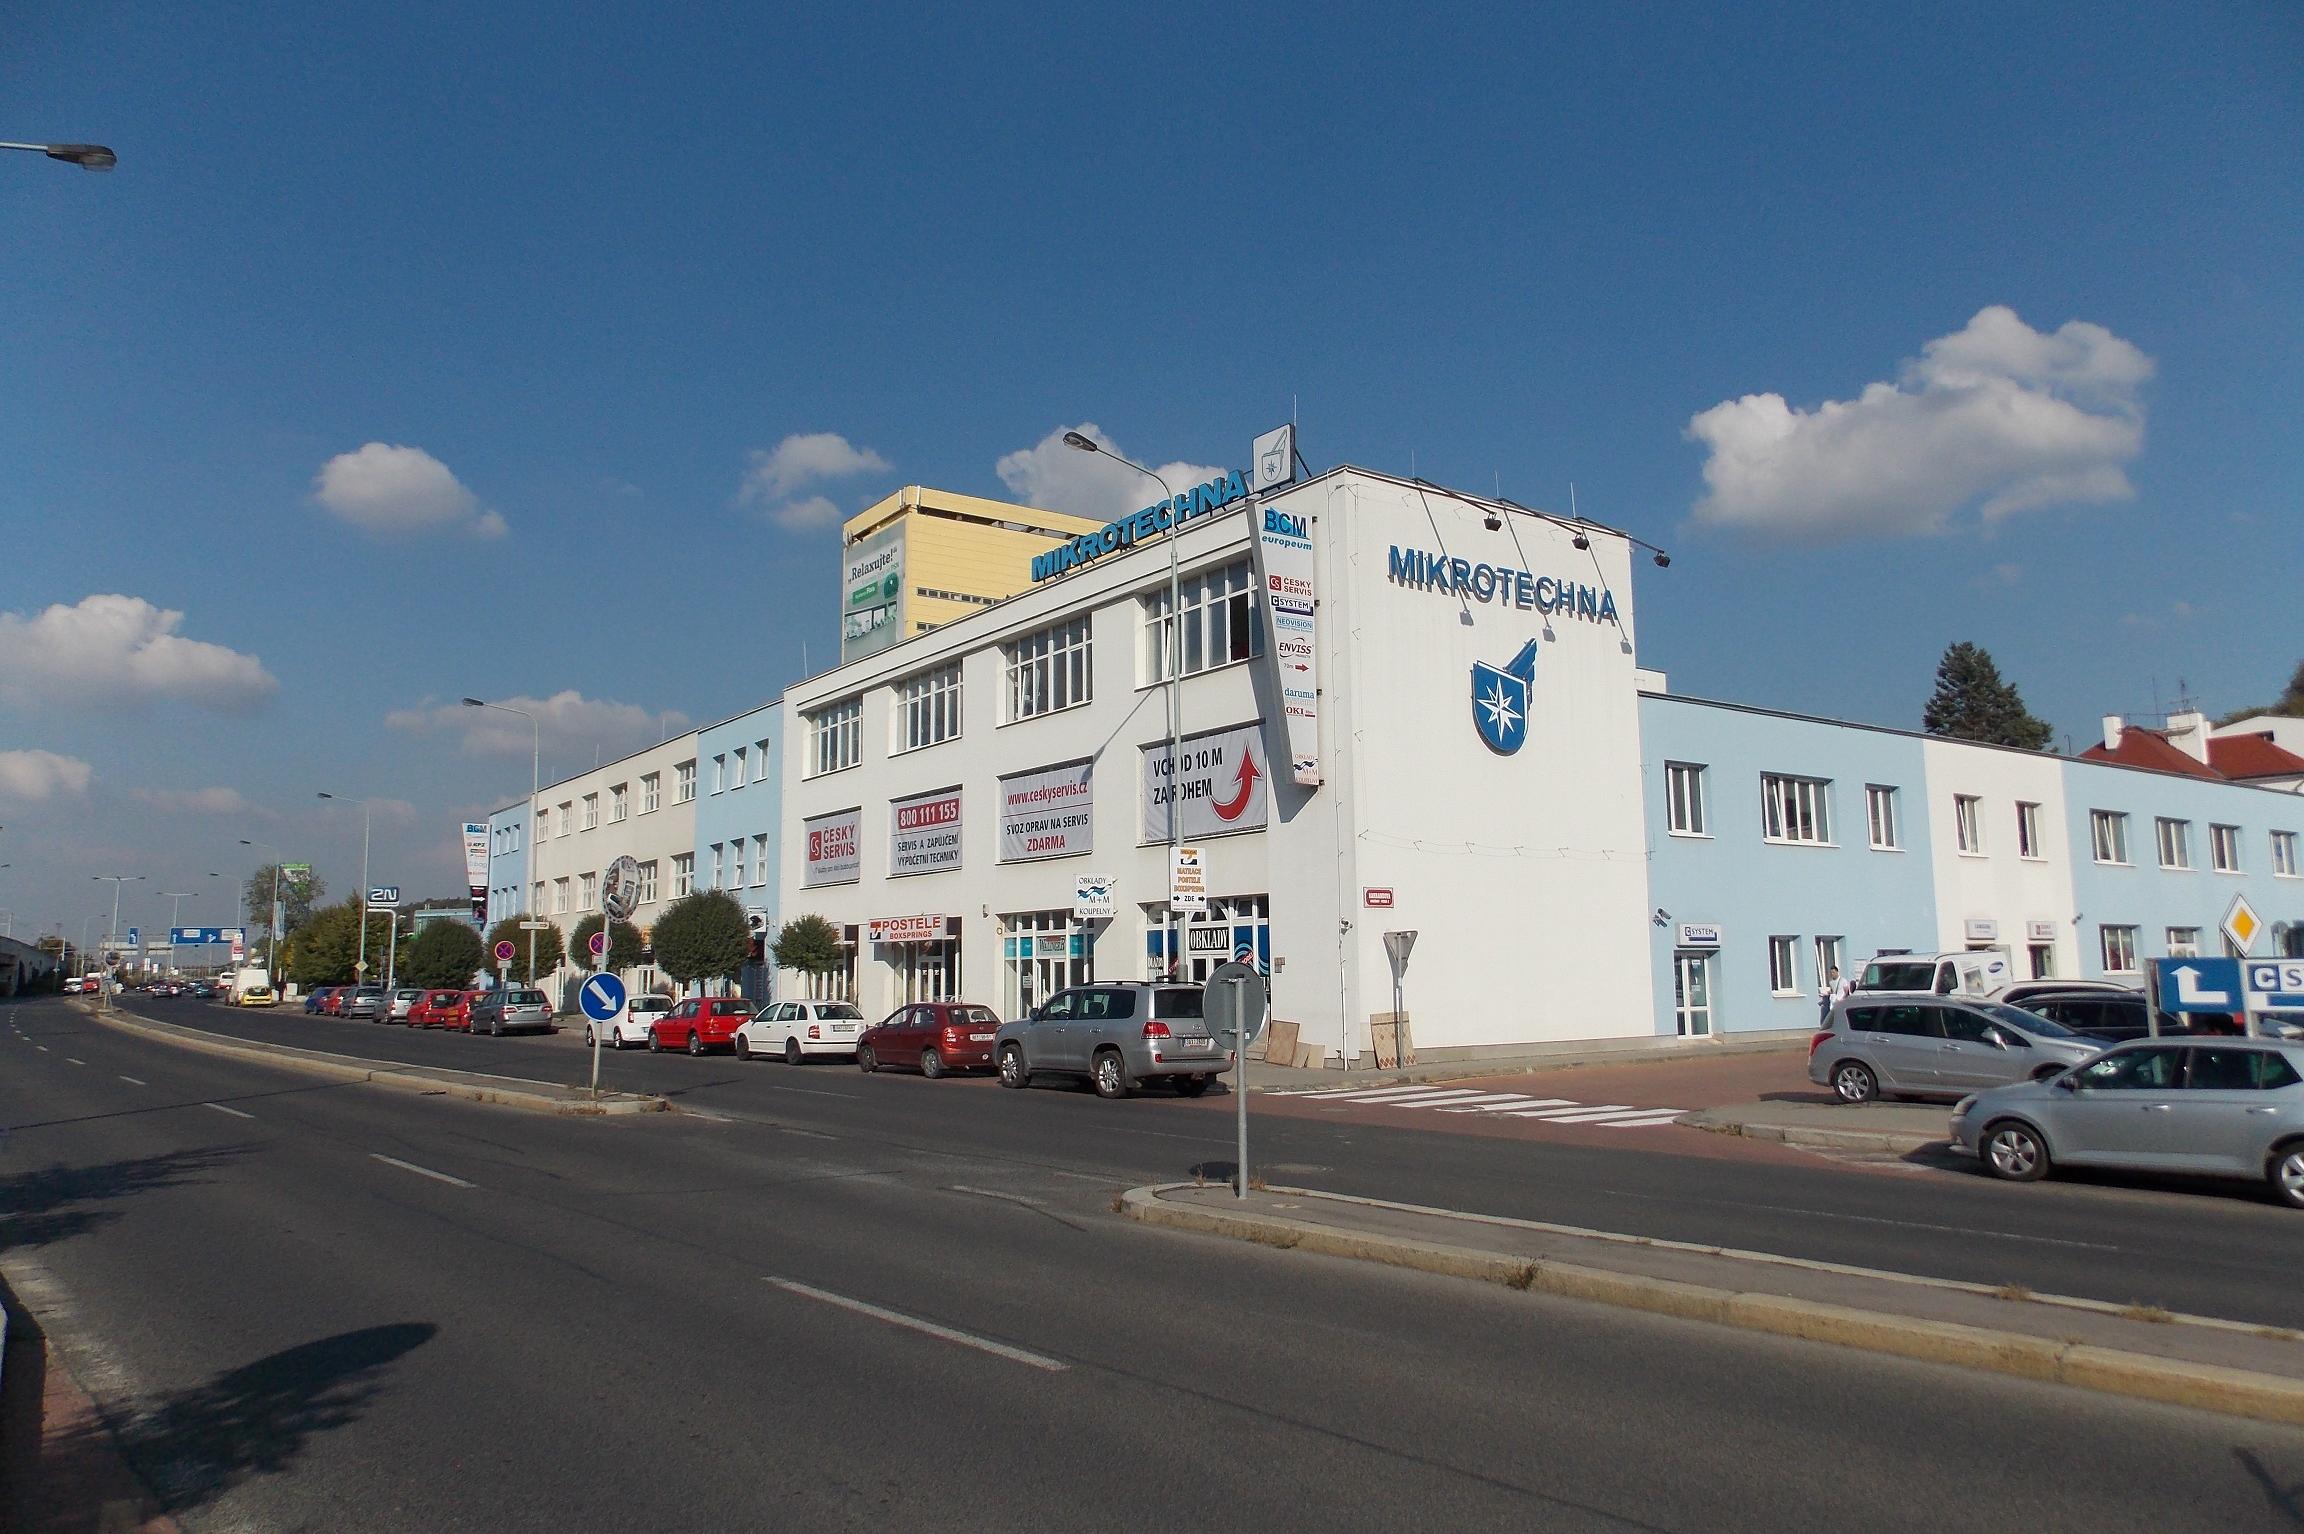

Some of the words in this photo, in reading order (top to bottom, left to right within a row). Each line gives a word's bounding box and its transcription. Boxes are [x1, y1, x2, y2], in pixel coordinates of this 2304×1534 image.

[1031, 469, 1250, 582] MIKROTECHNA
[1261, 535, 1312, 550] europeum
[1283, 585, 1312, 597] SERVIS
[1389, 545, 1618, 624] MIKROTECHNA
[1276, 617, 1312, 629] NEOVISION
[1279, 642, 1312, 655] ENVISS
[1284, 688, 1316, 699] daruma
[1286, 706, 1304, 715] OKI
[1196, 750, 1208, 769] 10
[1211, 747, 1222, 766] M
[1007, 780, 1088, 805] www.ceskyservis.cz
[1154, 786, 1168, 804] ZA
[900, 809, 917, 827] 800
[919, 805, 936, 824] 111
[938, 802, 957, 820] 155
[1006, 823, 1024, 835] SVOZ
[1025, 819, 1049, 833] OPRAV
[1050, 817, 1061, 830] NA
[1063, 813, 1089, 828] SERVIS
[823, 821, 855, 843] ČESKÝ
[823, 841, 856, 859] SERVIS
[897, 840, 917, 852] SERVIS
[920, 839, 924, 849] A
[1027, 834, 1066, 851] ZDARMA
[929, 849, 959, 863] TECHNIKY
[371, 889, 397, 900] 2N
[1080, 907, 1110, 915] KOUPELNY
[882, 916, 941, 931] POSTELE
[889, 930, 932, 940] BOXSPRINGS
[1190, 929, 1228, 949] OBKLADY
